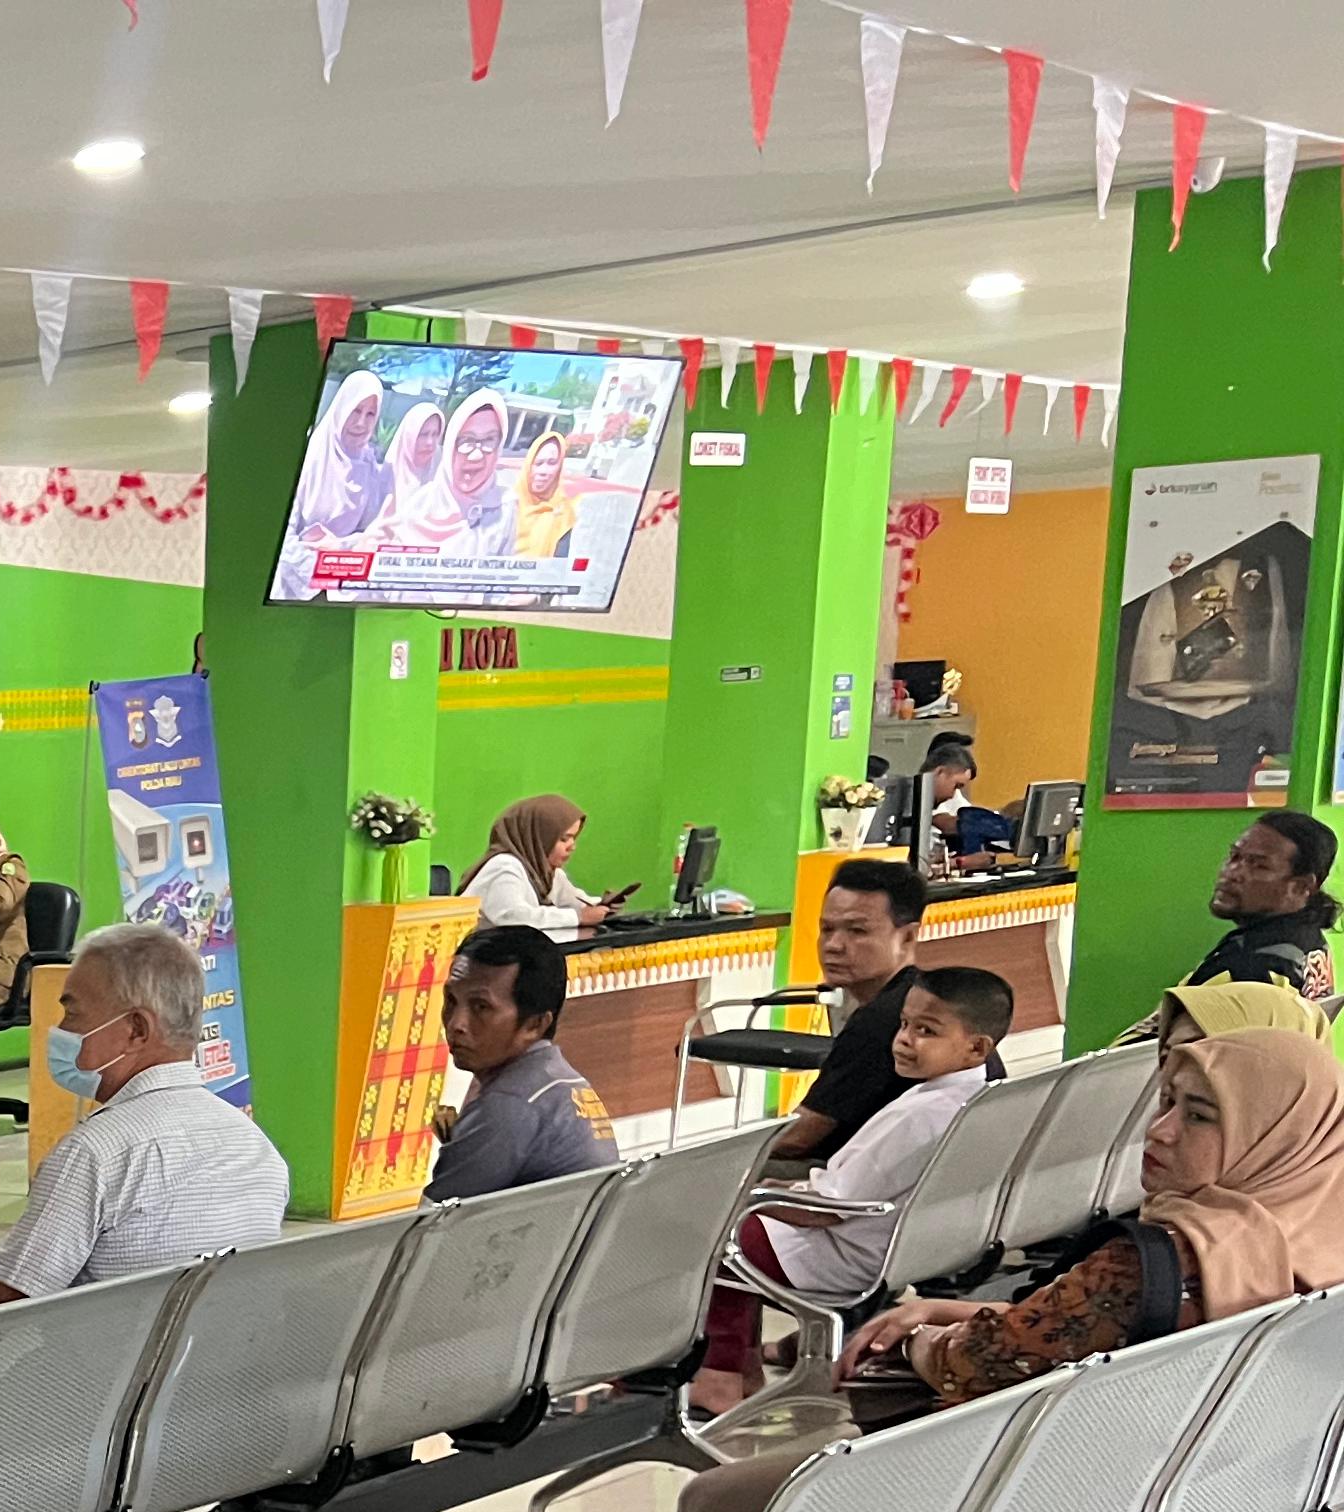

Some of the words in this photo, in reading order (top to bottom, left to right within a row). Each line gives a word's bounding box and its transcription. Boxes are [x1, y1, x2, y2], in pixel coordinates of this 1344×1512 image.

[459, 626, 518, 671] KOTA
[200, 955, 216, 970] ATI
[202, 990, 235, 1010] NTAS
